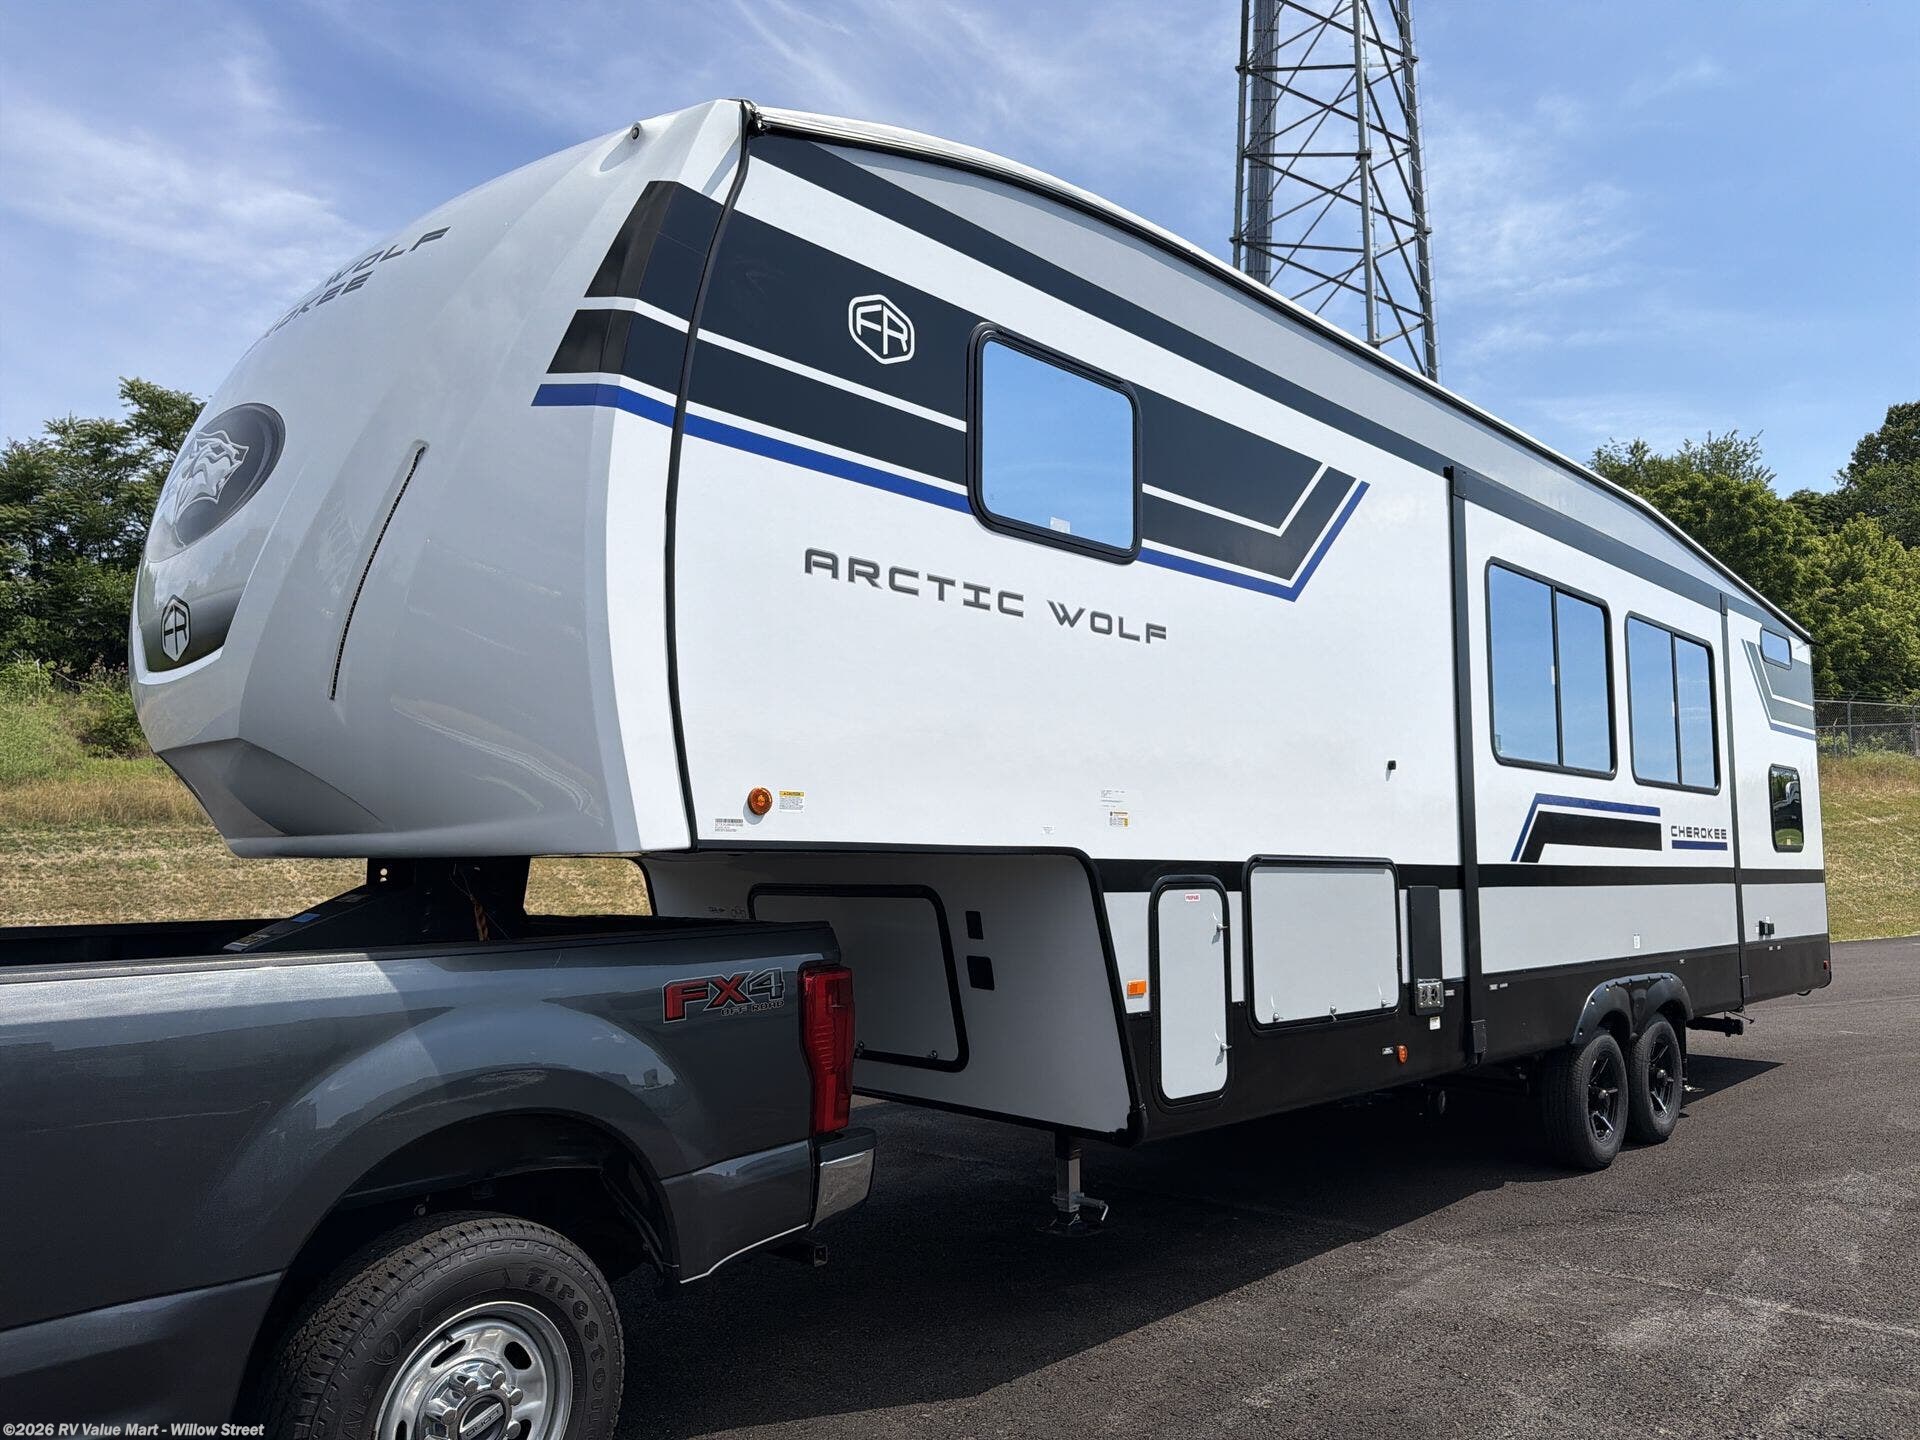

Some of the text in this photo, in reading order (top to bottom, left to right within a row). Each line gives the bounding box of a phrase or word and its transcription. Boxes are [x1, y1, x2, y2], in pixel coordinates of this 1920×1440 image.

[804, 547, 1167, 644] ARCTIC WOLF
[1670, 825, 1727, 840] CHEROKEE
[662, 967, 786, 1024] FX4
[720, 999, 785, 1017] OFF ROAD
